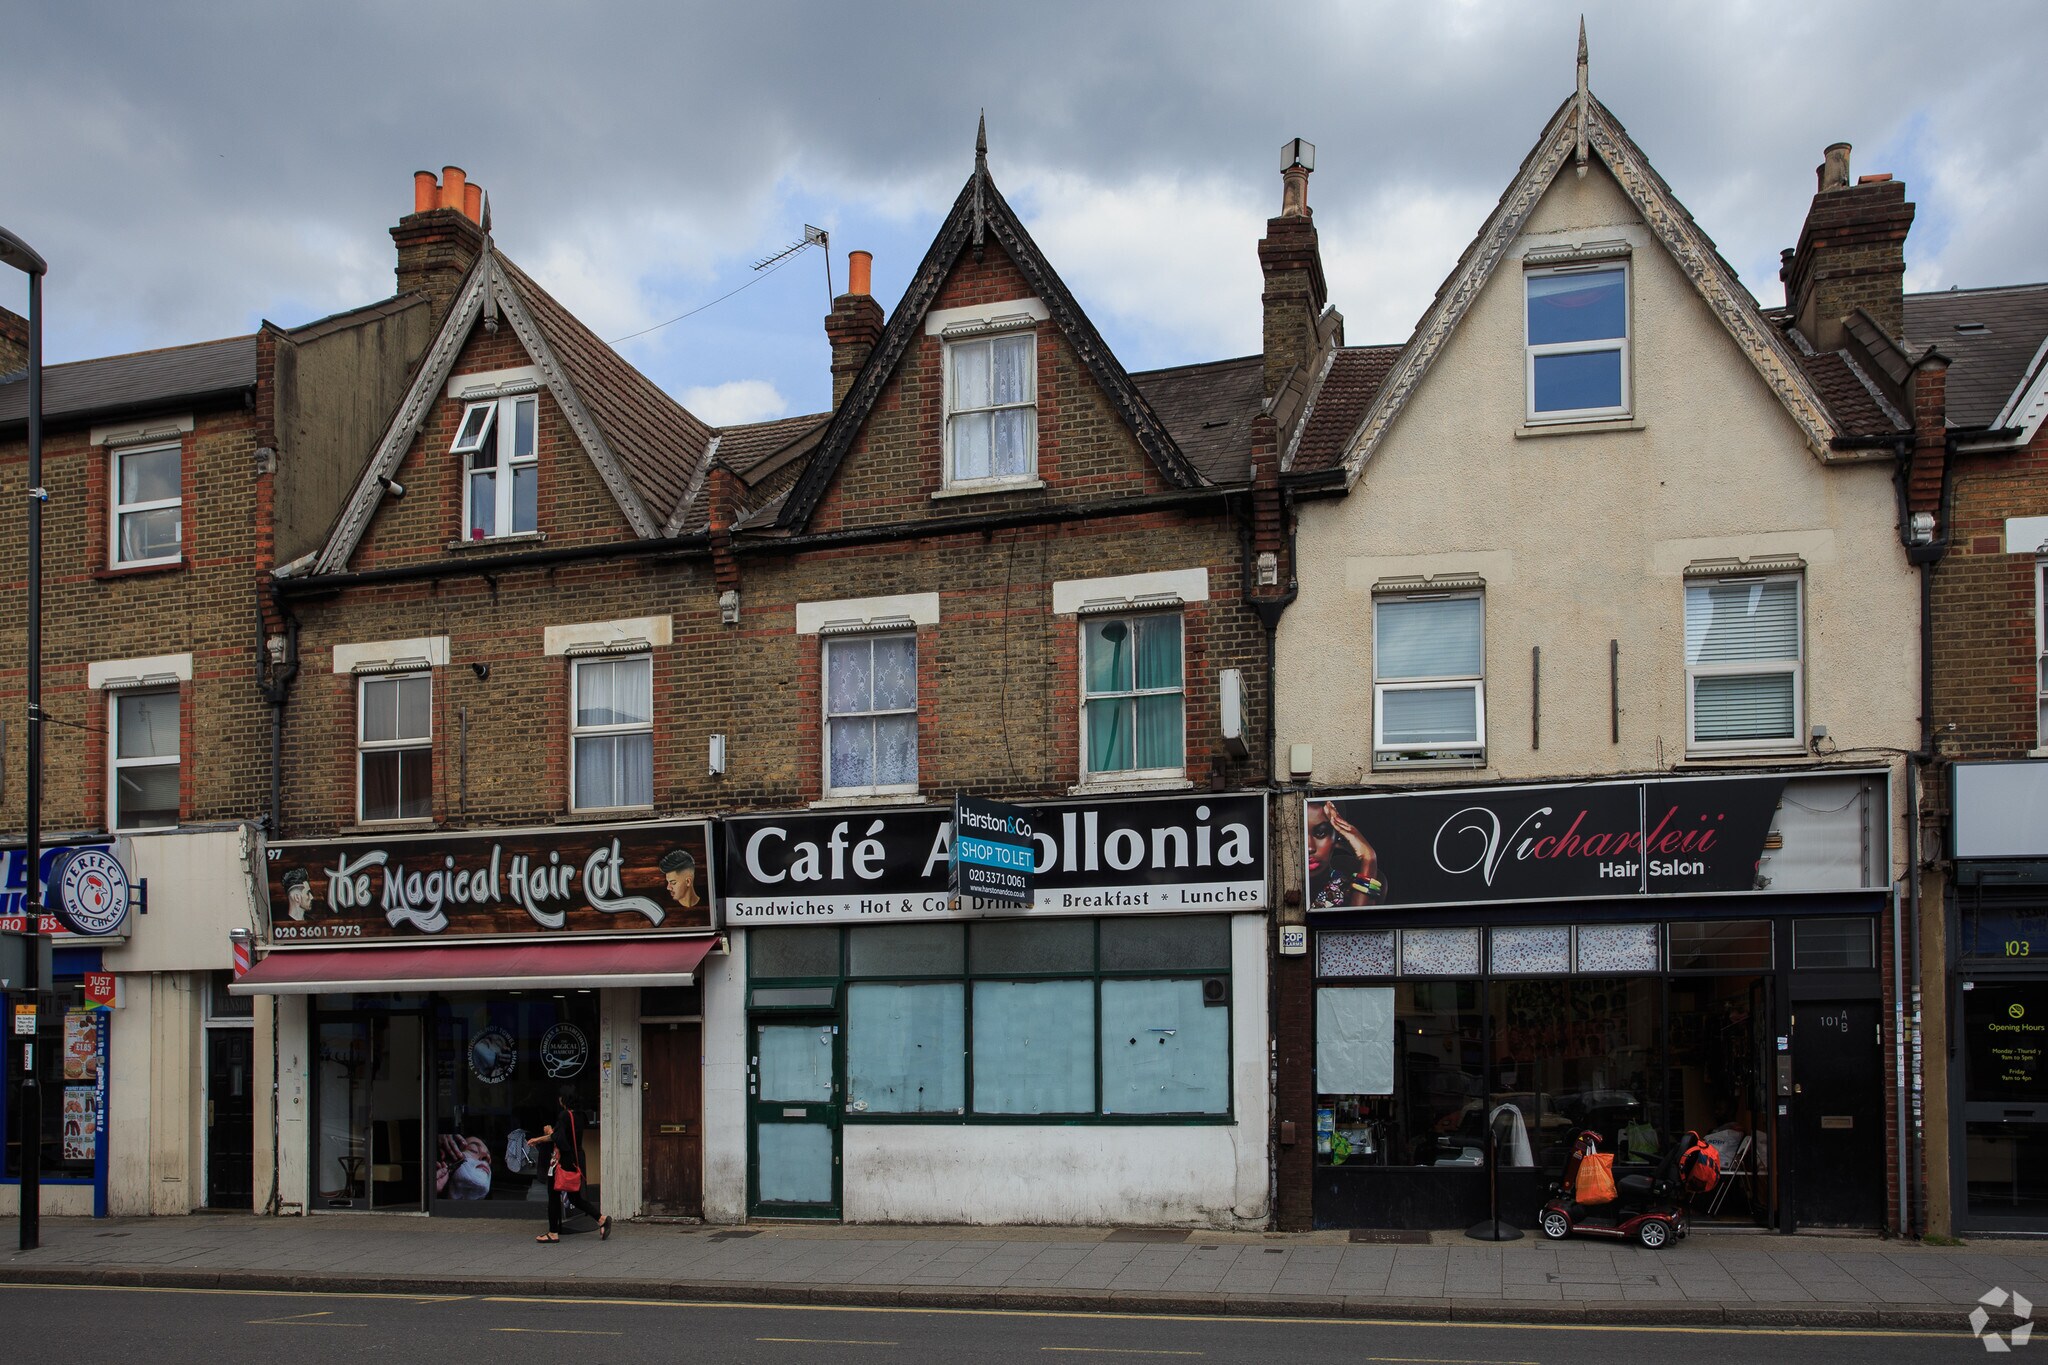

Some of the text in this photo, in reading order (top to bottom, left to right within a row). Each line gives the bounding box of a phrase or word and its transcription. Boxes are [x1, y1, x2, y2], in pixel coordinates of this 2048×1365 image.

[960, 806, 1032, 837] Harston&Co
[745, 805, 1255, 884] Café Aollonia
[267, 849, 282, 860] 97
[962, 841, 993, 860] SHOP
[995, 847, 1011, 863] TO
[1013, 851, 1031, 867] LET
[66, 856, 123, 888] PERFECT
[1599, 858, 1704, 878] Hair Salon
[380, 844, 502, 934] Magical
[506, 850, 576, 929] Hair
[582, 837, 666, 927] Cut
[969, 869, 1026, 888] 020 3371 0061
[970, 885, 1026, 898] www.harstonandco.co.uk
[735, 900, 834, 916] Sandwiches
[860, 900, 891, 913] Hot
[901, 899, 913, 912] &
[1062, 891, 1149, 908] Breakfast
[1181, 887, 1258, 904] Lunches
[68, 899, 88, 923] FRIED
[91, 897, 123, 928] CHICKEN
[275, 925, 361, 939] 020 3601 7973
[2005, 940, 2030, 956] 103
[90, 976, 111, 987] JUST
[94, 987, 111, 996] EAT
[1820, 1016, 1838, 1026] 101
[1841, 1010, 1848, 1020] A
[1841, 1022, 1848, 1032] B
[1988, 1023, 2045, 1032] Opening Hours
[477, 1074, 506, 1084] AVAILABLE
